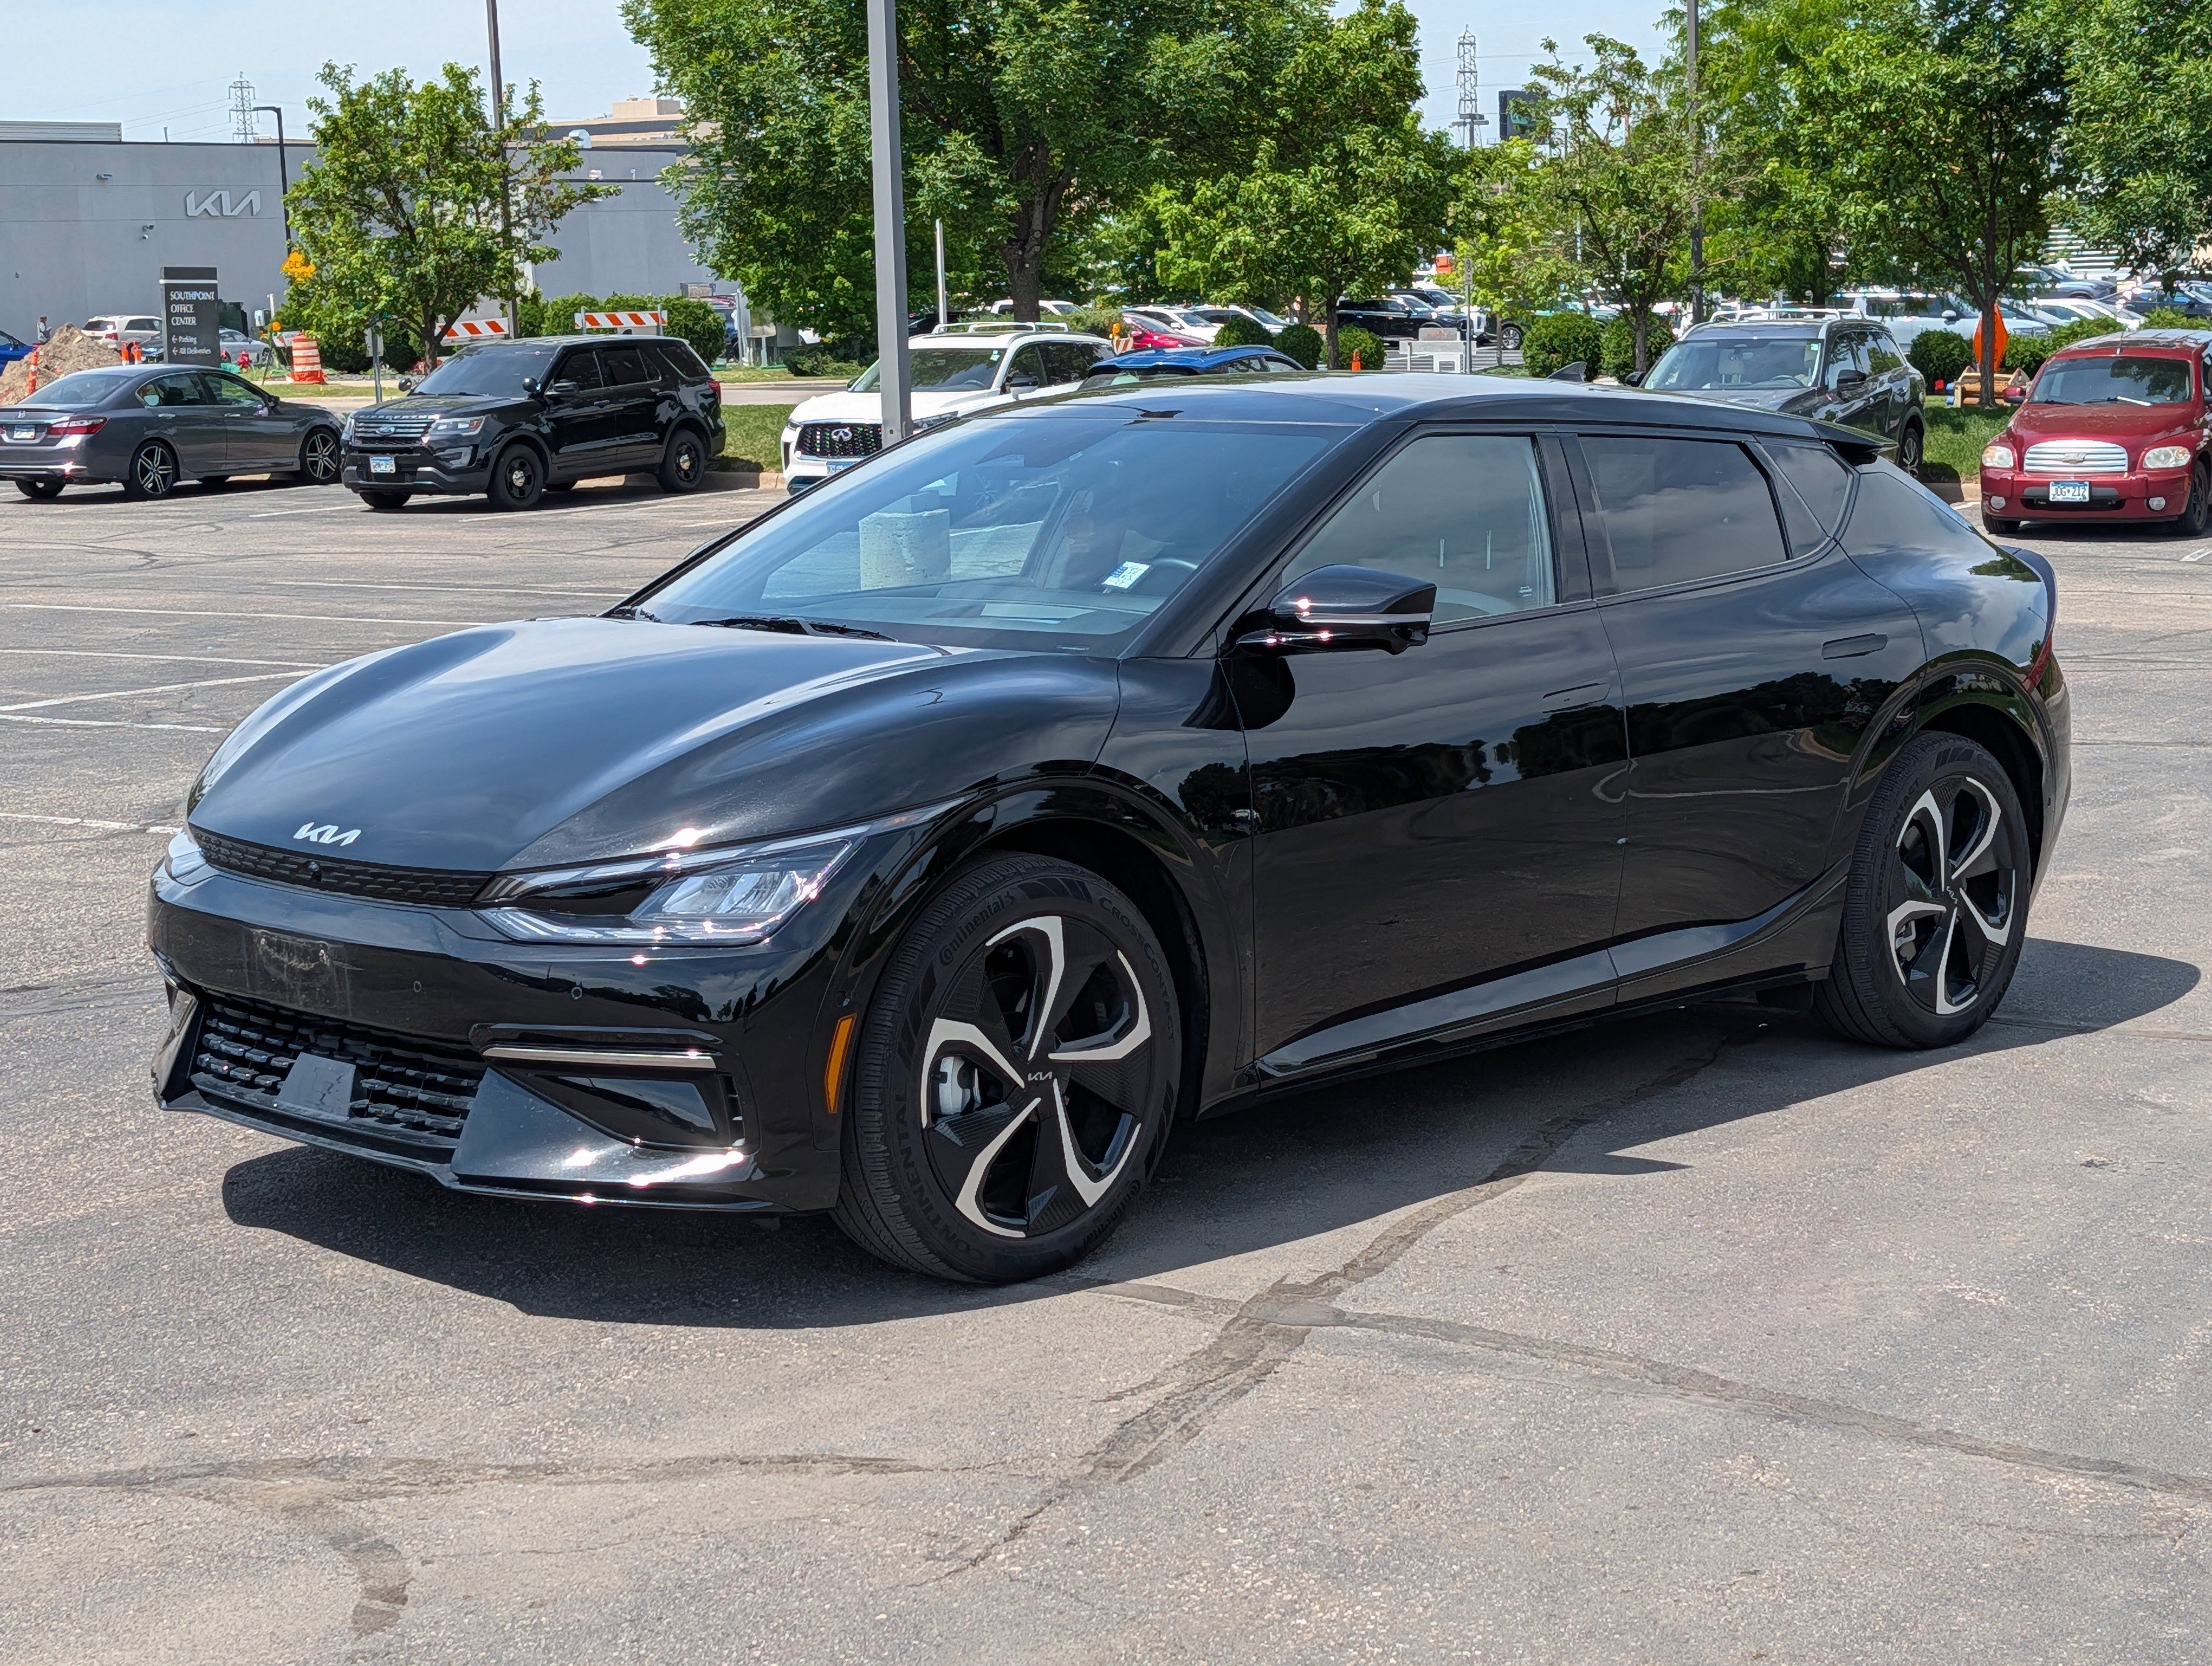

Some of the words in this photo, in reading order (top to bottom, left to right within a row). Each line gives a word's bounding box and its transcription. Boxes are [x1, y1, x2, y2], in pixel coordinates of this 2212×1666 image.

[187, 190, 260, 216] KIA
[170, 291, 215, 301] SOUTHPOINT
[170, 304, 195, 313] OFFICE
[171, 317, 197, 325] CENTER
[293, 822, 362, 847] KIA
[939, 895, 1005, 966] Continental
